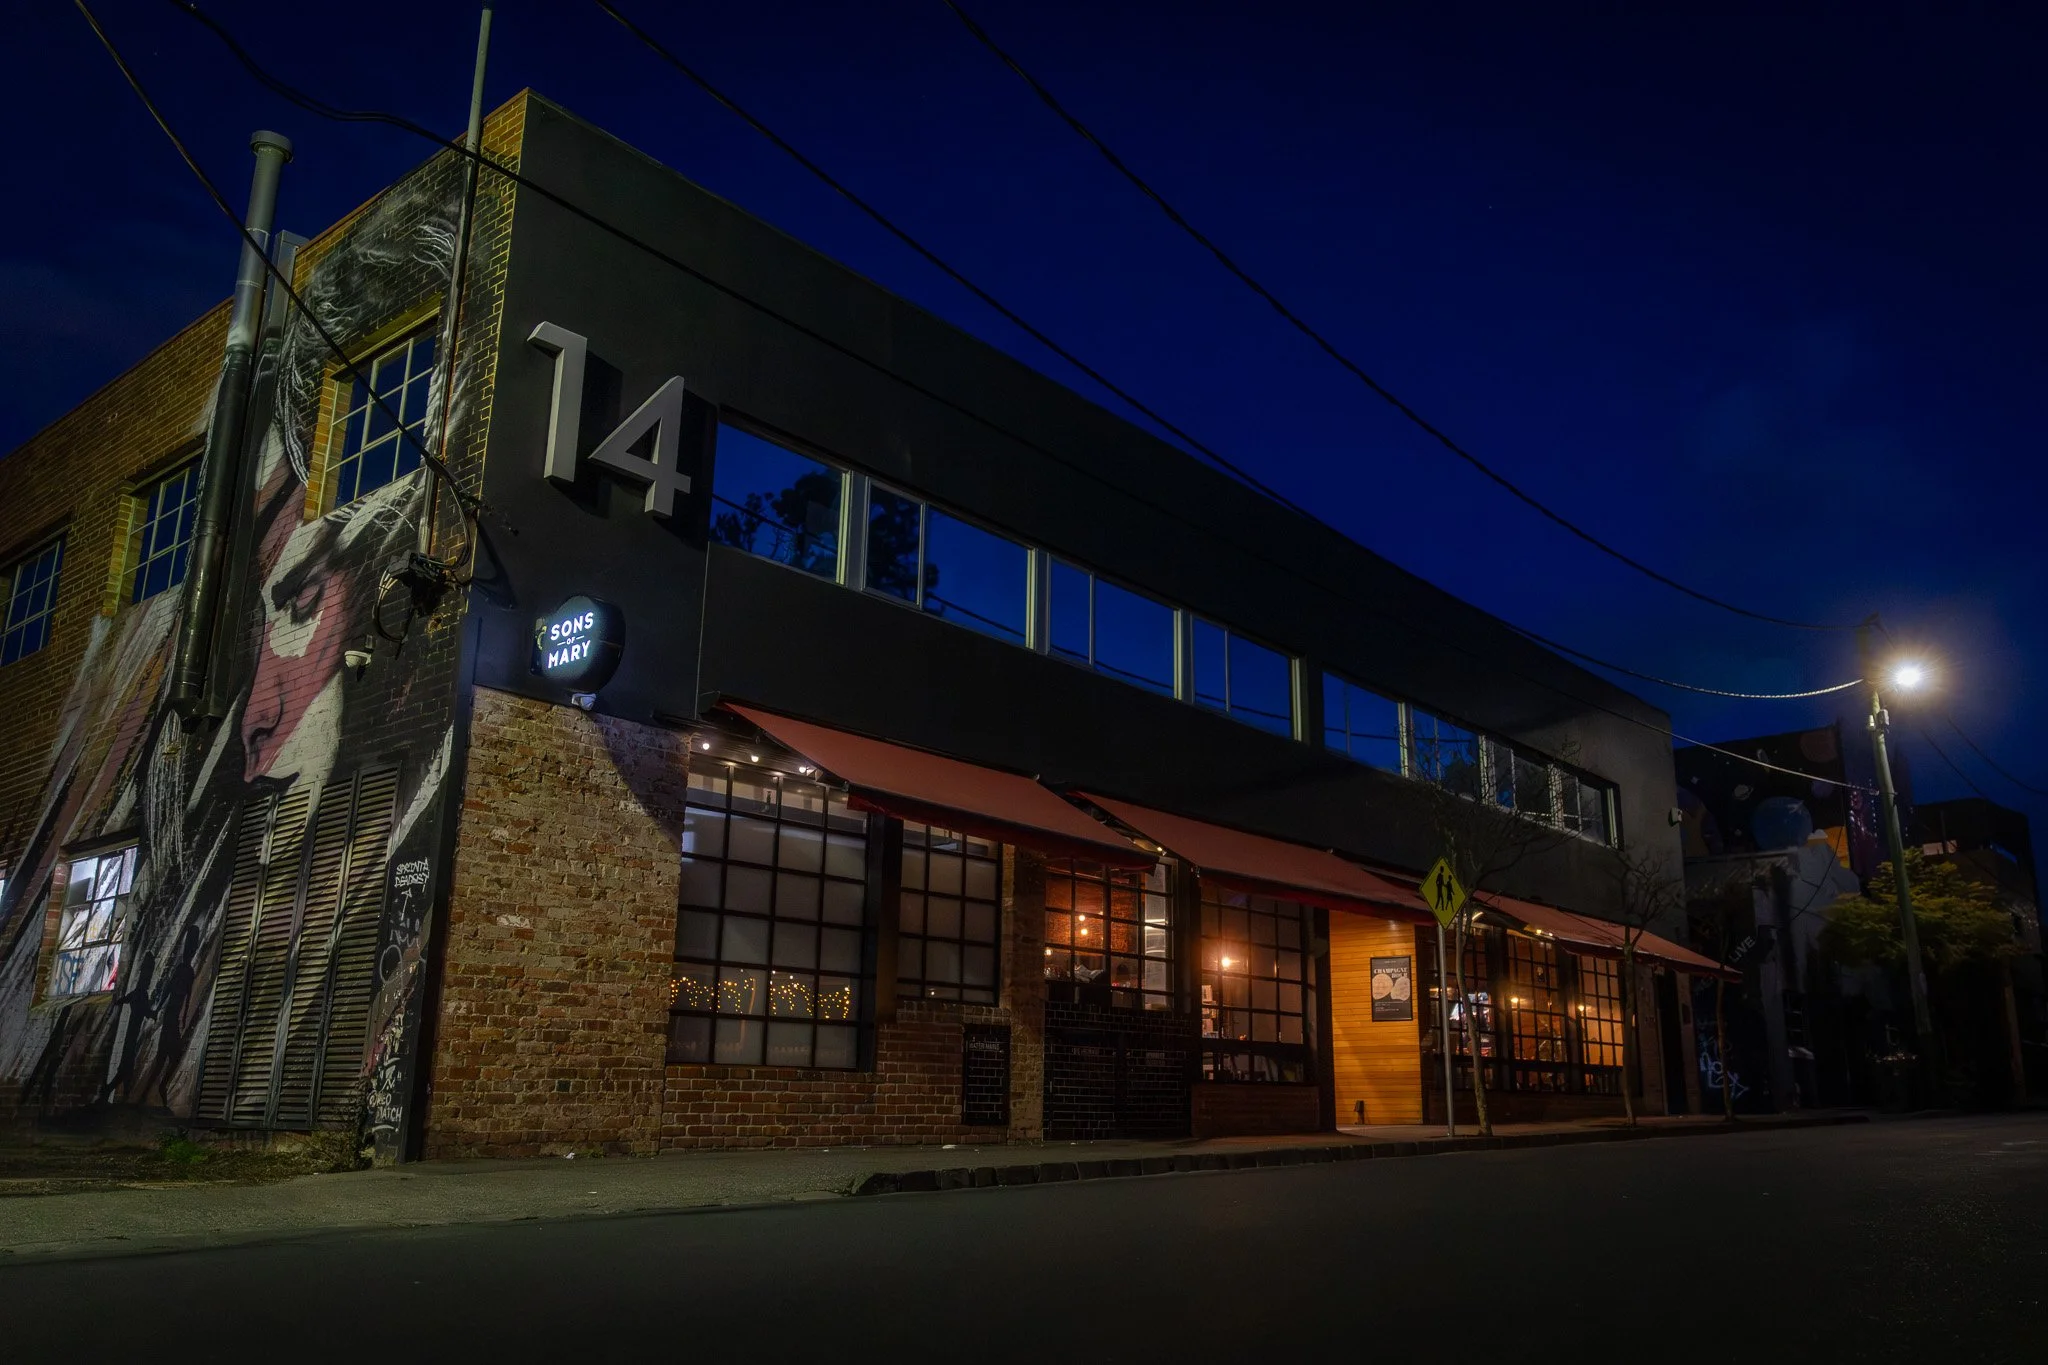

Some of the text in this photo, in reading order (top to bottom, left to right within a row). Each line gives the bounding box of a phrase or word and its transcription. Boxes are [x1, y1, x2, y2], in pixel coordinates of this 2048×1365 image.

[527, 321, 691, 517] 14
[550, 611, 594, 641] SONS
[566, 636, 576, 645] OF
[548, 639, 591, 669] MARY
